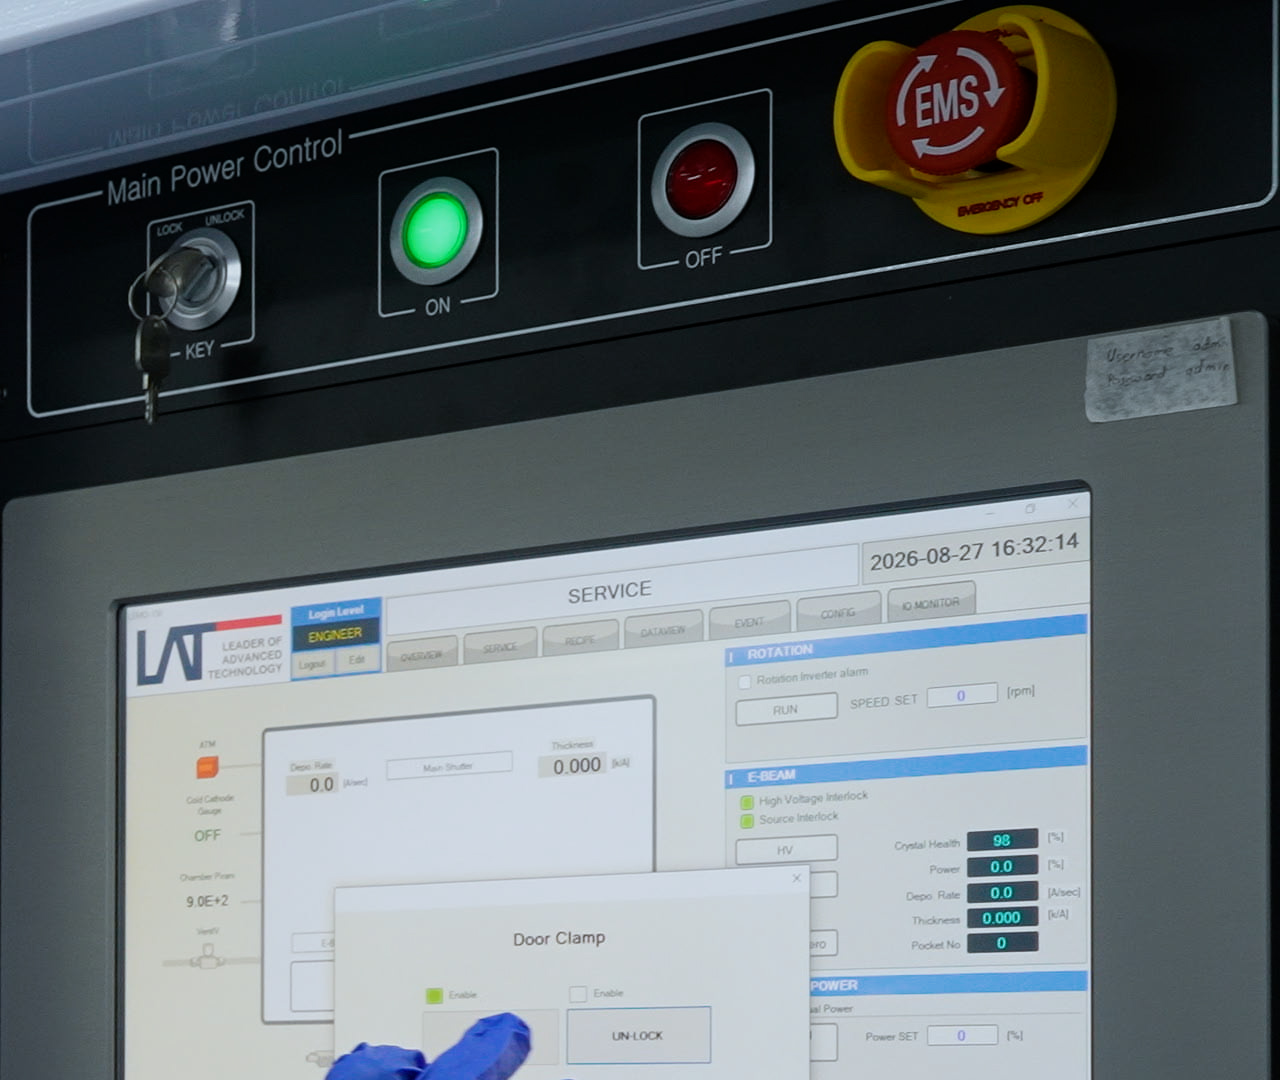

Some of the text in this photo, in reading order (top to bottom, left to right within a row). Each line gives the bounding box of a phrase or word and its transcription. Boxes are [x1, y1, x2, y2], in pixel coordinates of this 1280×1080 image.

[916, 75, 979, 128] EMS
[108, 128, 342, 206] Main Power Control
[958, 192, 1044, 217] EMERGENCY OFF
[205, 209, 245, 226] UNLOCK
[157, 222, 183, 237] LOCK
[685, 246, 722, 270] OFF
[425, 297, 451, 316] ON
[186, 340, 215, 359] KEY
[870, 532, 1080, 572] 2026-08-27 16:32:14
[568, 580, 652, 604] SERVICE
[309, 604, 364, 621] Login Level
[821, 608, 855, 619] CONFIG
[735, 617, 764, 628] EVENT
[308, 627, 362, 643] ENGINEER
[222, 636, 282, 652] LEADER OF
[137, 622, 216, 686] LAT
[222, 650, 282, 665] ADVANCED
[748, 644, 813, 660] ROTATION
[349, 655, 365, 665] Edit
[208, 663, 282, 679] TECHNOLOGY
[757, 667, 868, 685] Rotation Inverter alarm
[850, 684, 1035, 709] SPEED SET [rpm]
[773, 704, 798, 716] RUN
[554, 757, 601, 775] 0.000
[748, 769, 796, 783] E-BEAM
[310, 777, 334, 792] 0.0
[759, 790, 868, 808] High Voltage Interlock
[760, 810, 839, 825] Source Interlock
[194, 829, 221, 842] OFF
[894, 834, 1010, 851] Crystal Health 98
[778, 846, 793, 855] HV
[930, 860, 1012, 874] Power 0.0
[938, 886, 1012, 899] Rate 0.0
[187, 894, 228, 908] 9.0E+2
[912, 912, 1020, 925] Thickness 0.000
[513, 931, 606, 947] Door Clamp
[912, 937, 1006, 951] Pocket No 0
[811, 979, 858, 991] POWER
[594, 989, 624, 998] Enable
[824, 1004, 853, 1013] Power
[612, 1031, 663, 1041] UN-LOCK
[866, 1032, 919, 1042] Power SET
